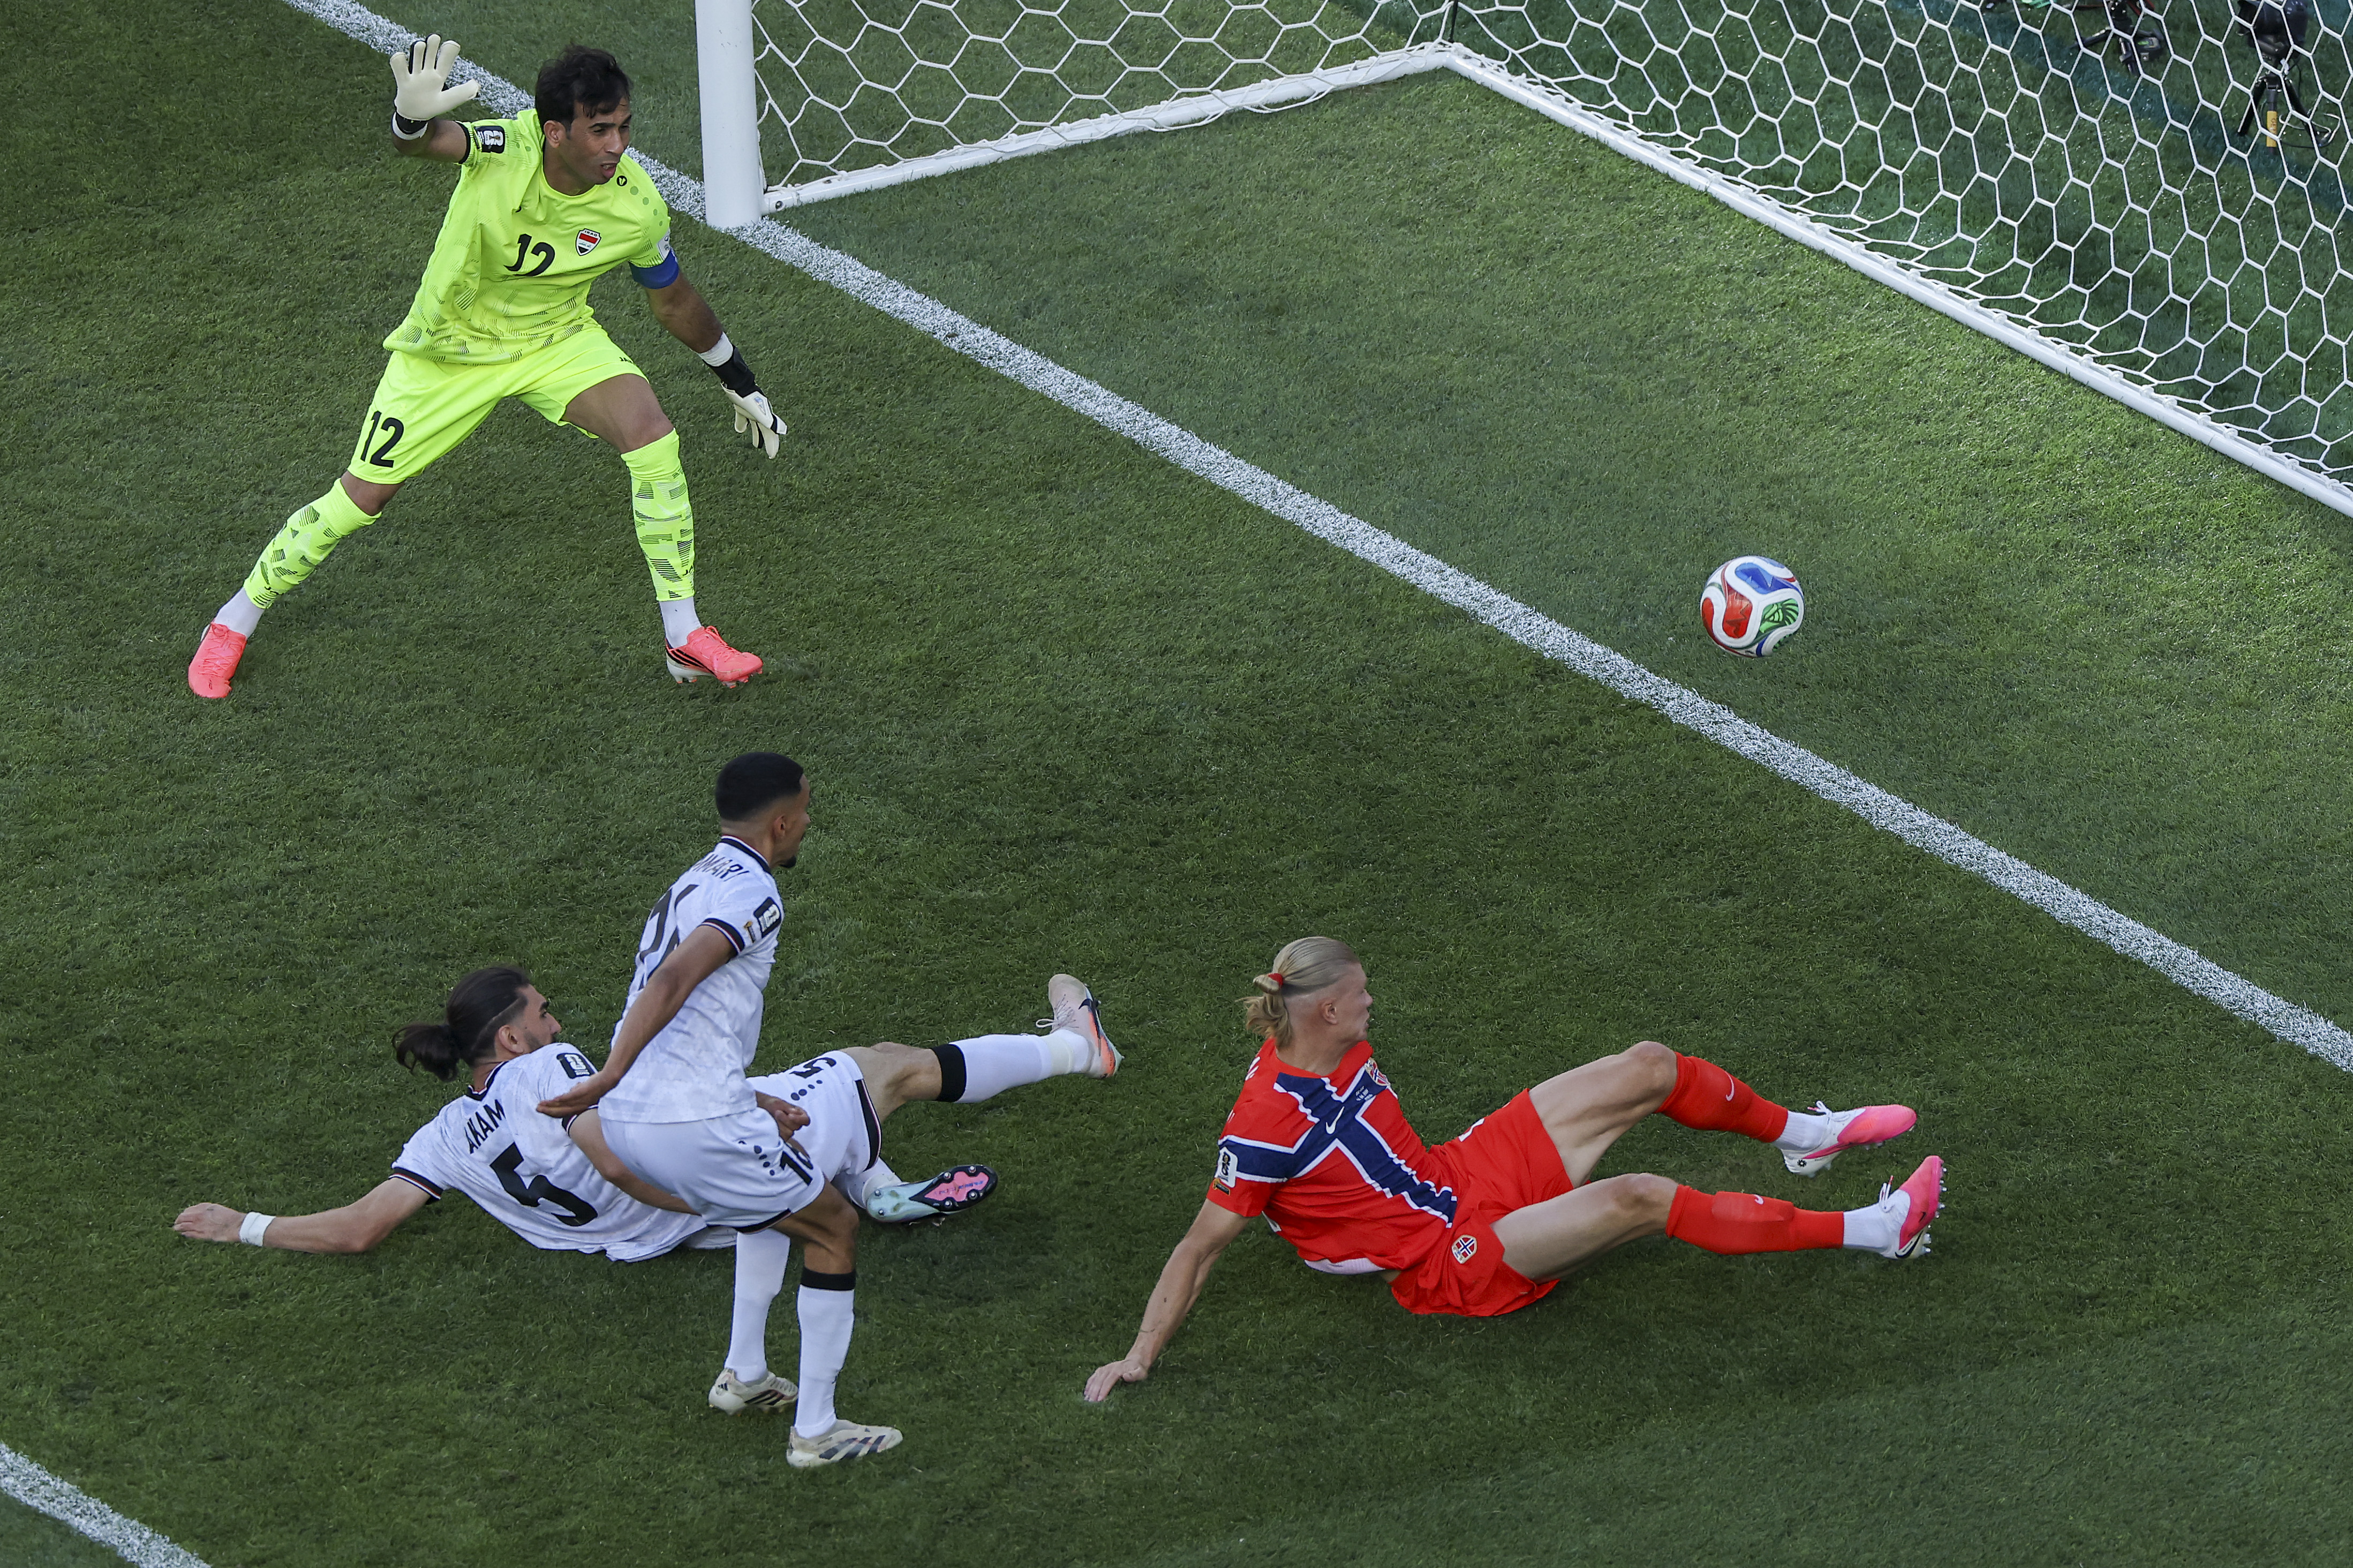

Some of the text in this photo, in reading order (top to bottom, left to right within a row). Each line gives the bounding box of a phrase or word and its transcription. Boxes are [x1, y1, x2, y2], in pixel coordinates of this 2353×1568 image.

[503, 233, 555, 277] 12
[360, 410, 404, 469] 12
[464, 1099, 506, 1155] AKAM
[489, 1141, 599, 1227] 5
